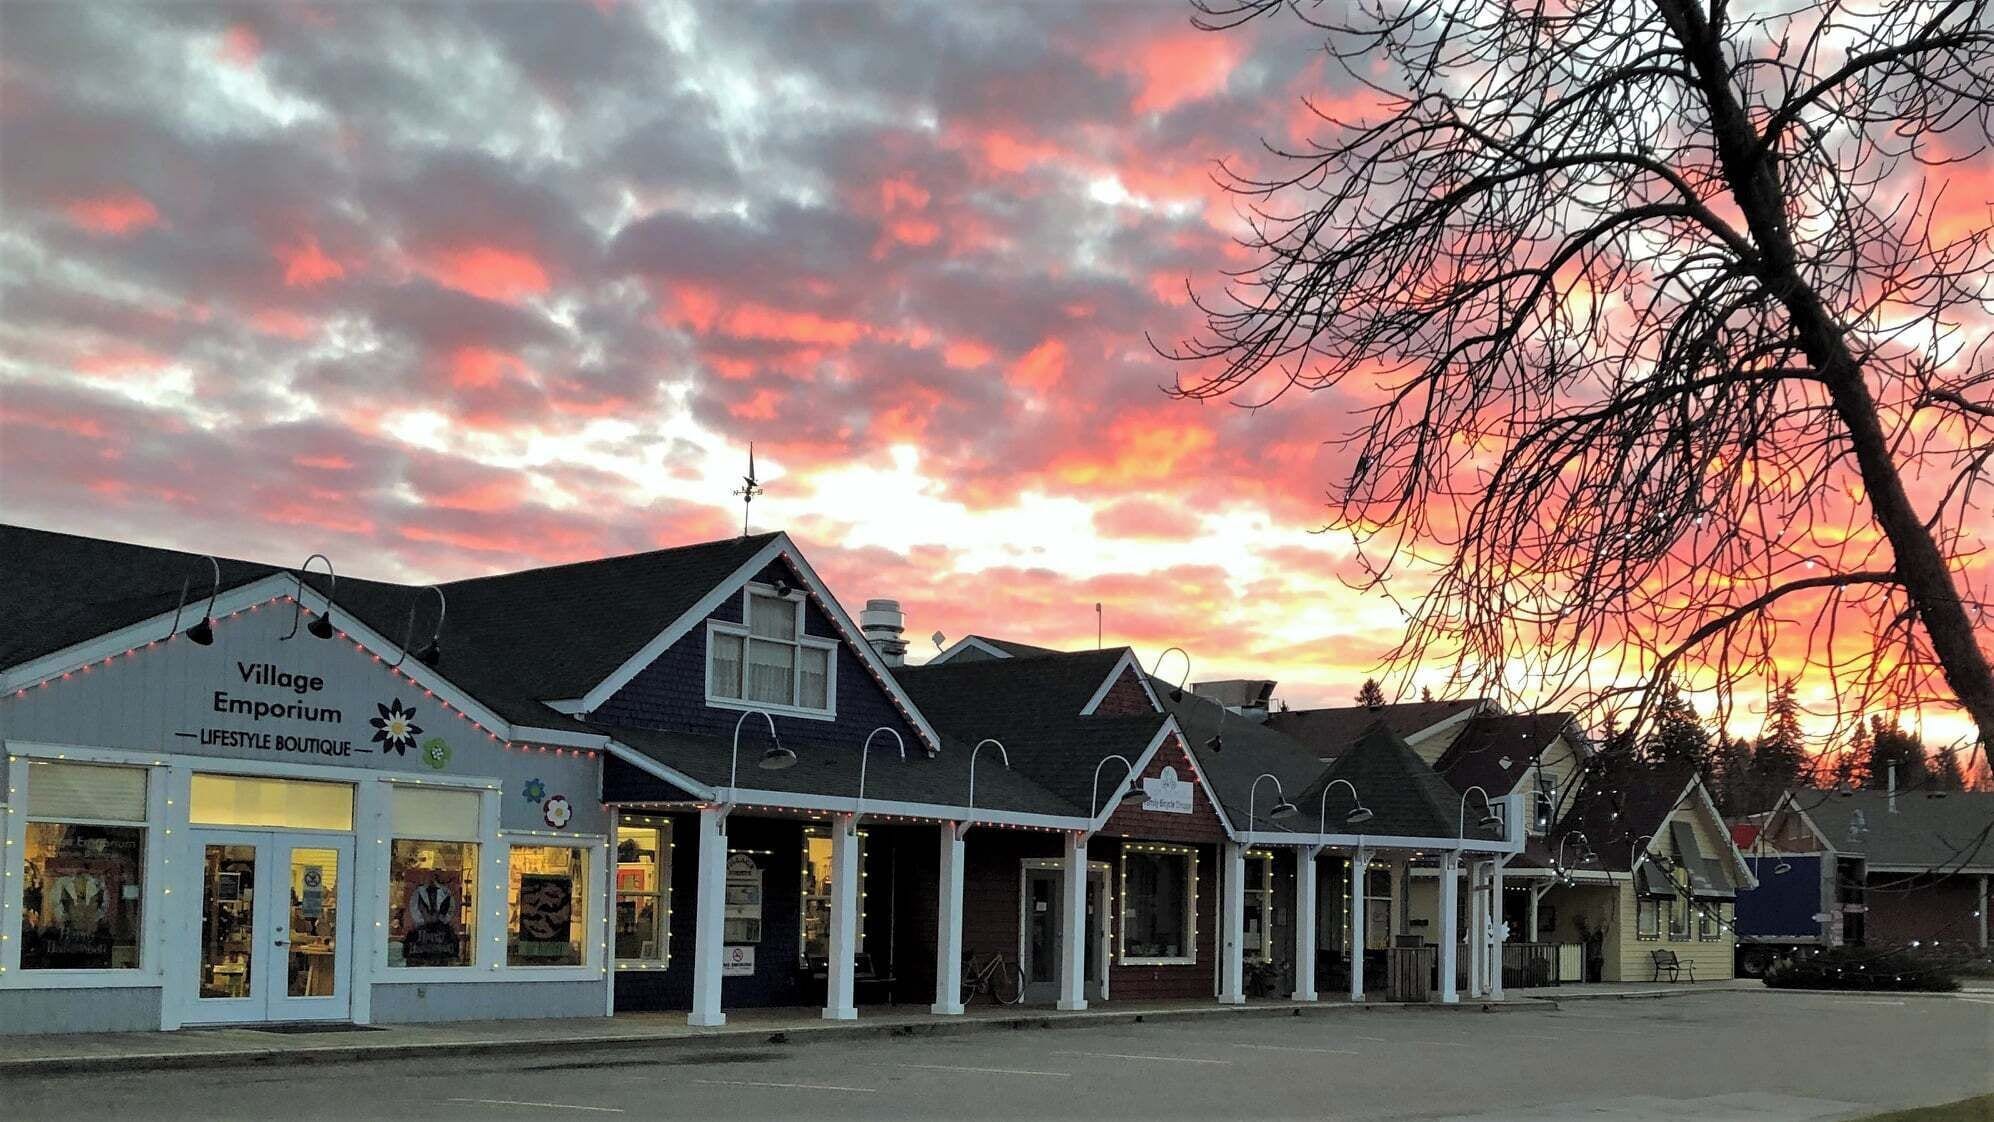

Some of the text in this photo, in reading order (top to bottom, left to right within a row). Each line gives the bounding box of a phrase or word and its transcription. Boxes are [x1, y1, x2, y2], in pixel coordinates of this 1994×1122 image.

[237, 661, 324, 694] Village
[213, 691, 342, 724] Emporium
[200, 728, 351, 757] LIFESTYLE BOUTIQUE
